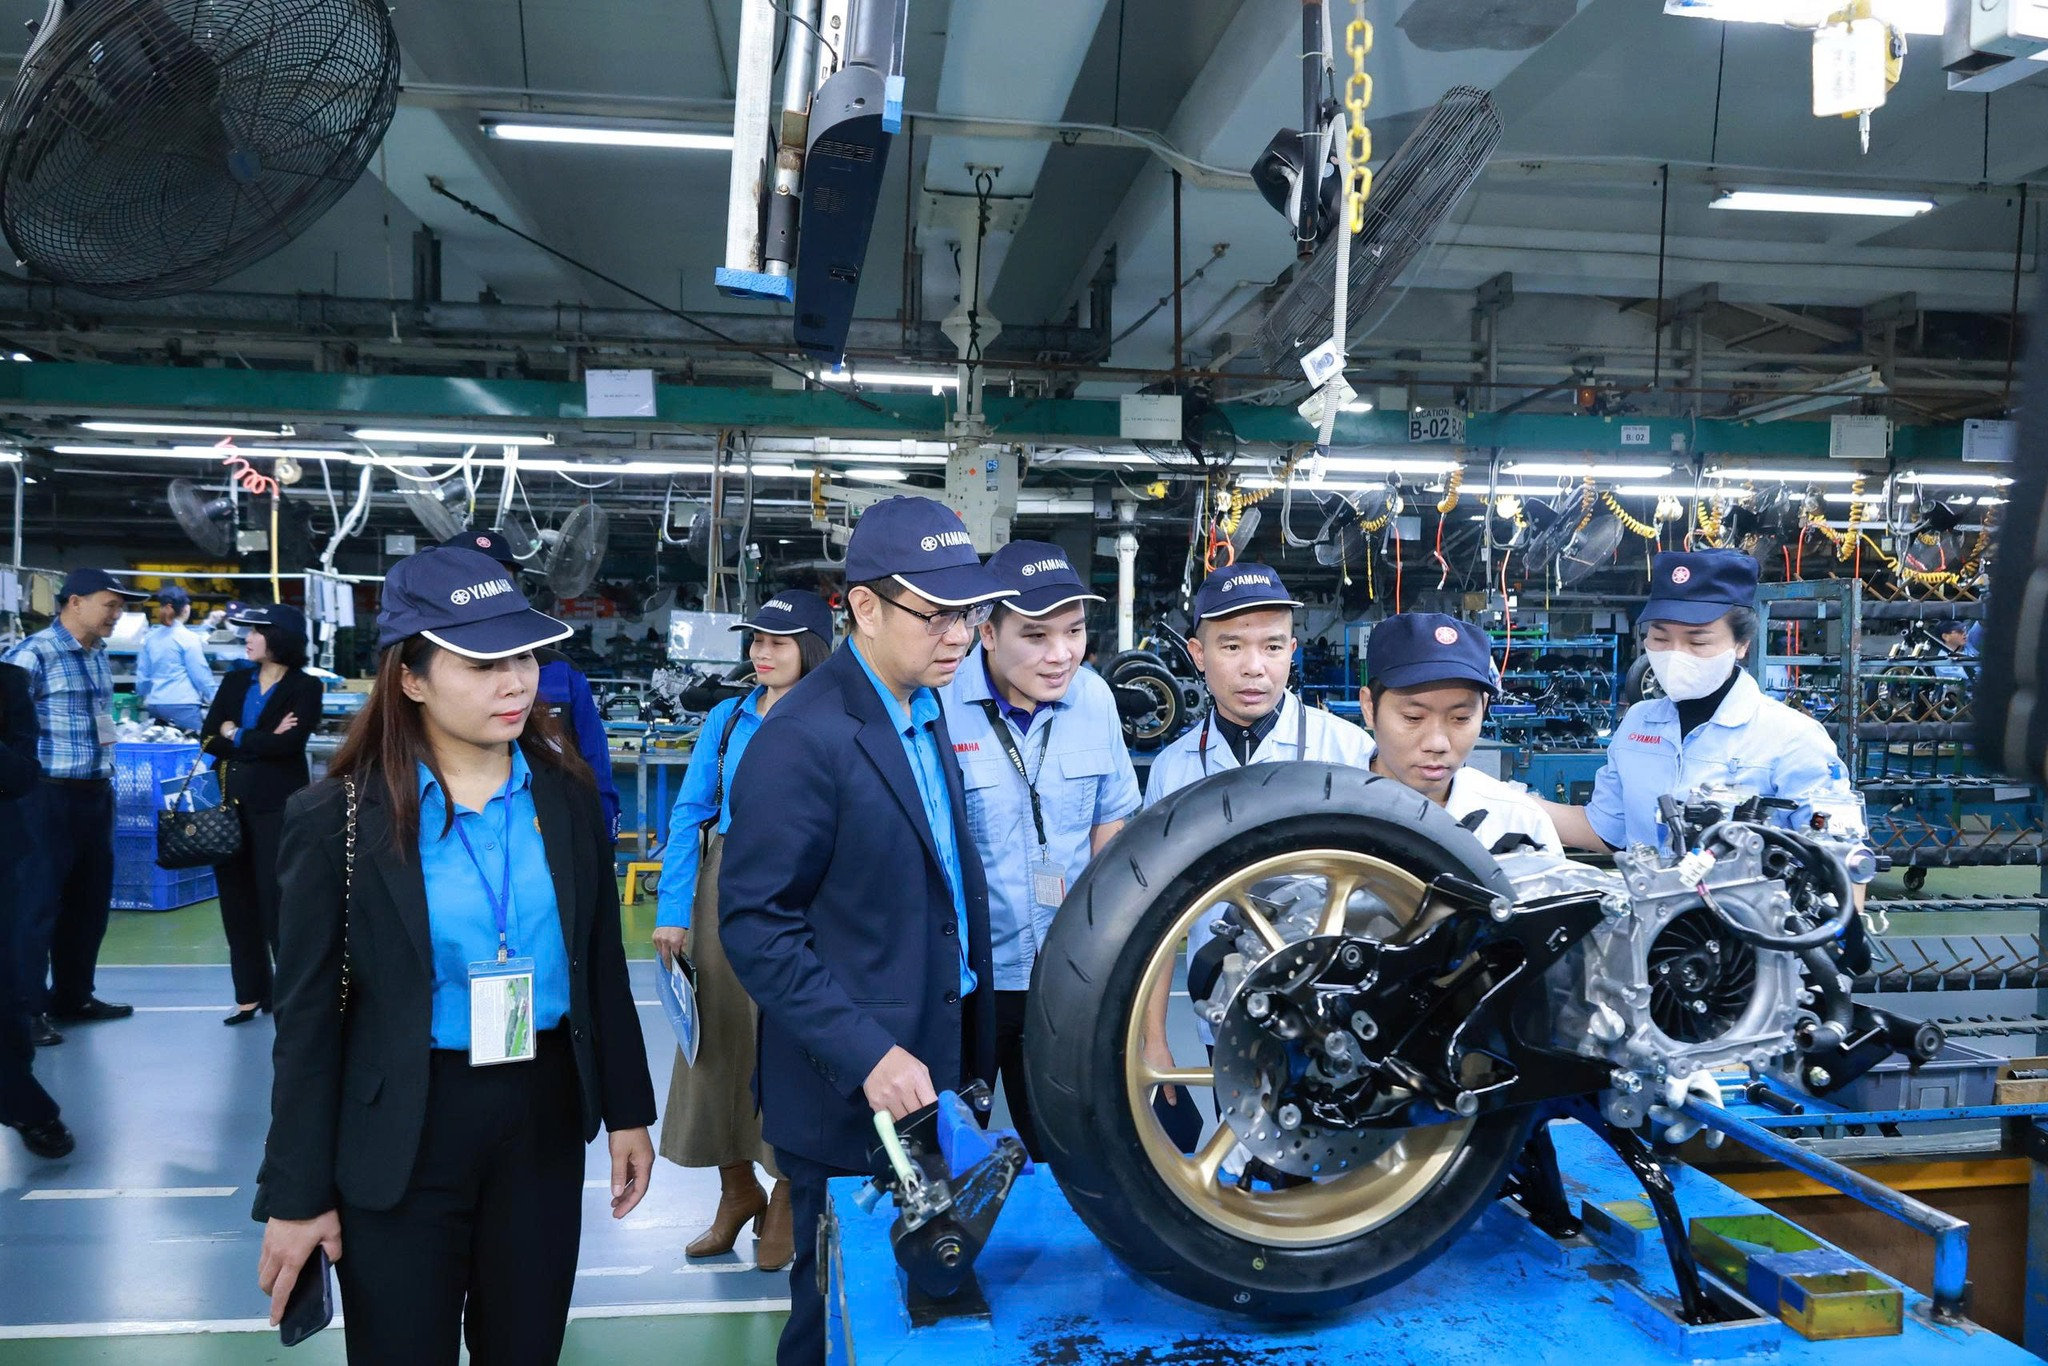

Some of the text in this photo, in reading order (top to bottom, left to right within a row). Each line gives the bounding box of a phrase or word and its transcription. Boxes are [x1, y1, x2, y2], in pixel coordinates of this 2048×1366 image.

[1411, 409, 1450, 419] LOCATION
[1410, 417, 1449, 440] B-02
[987, 460, 998, 470] CS
[1033, 559, 1070, 572] YAMAHA
[1230, 574, 1271, 587] YAMAHA
[467, 578, 514, 600] YAMAHA
[1635, 734, 1660, 744] YAMAHA
[952, 742, 980, 752] AMAHA
[1009, 747, 1026, 776] YAMAHA
